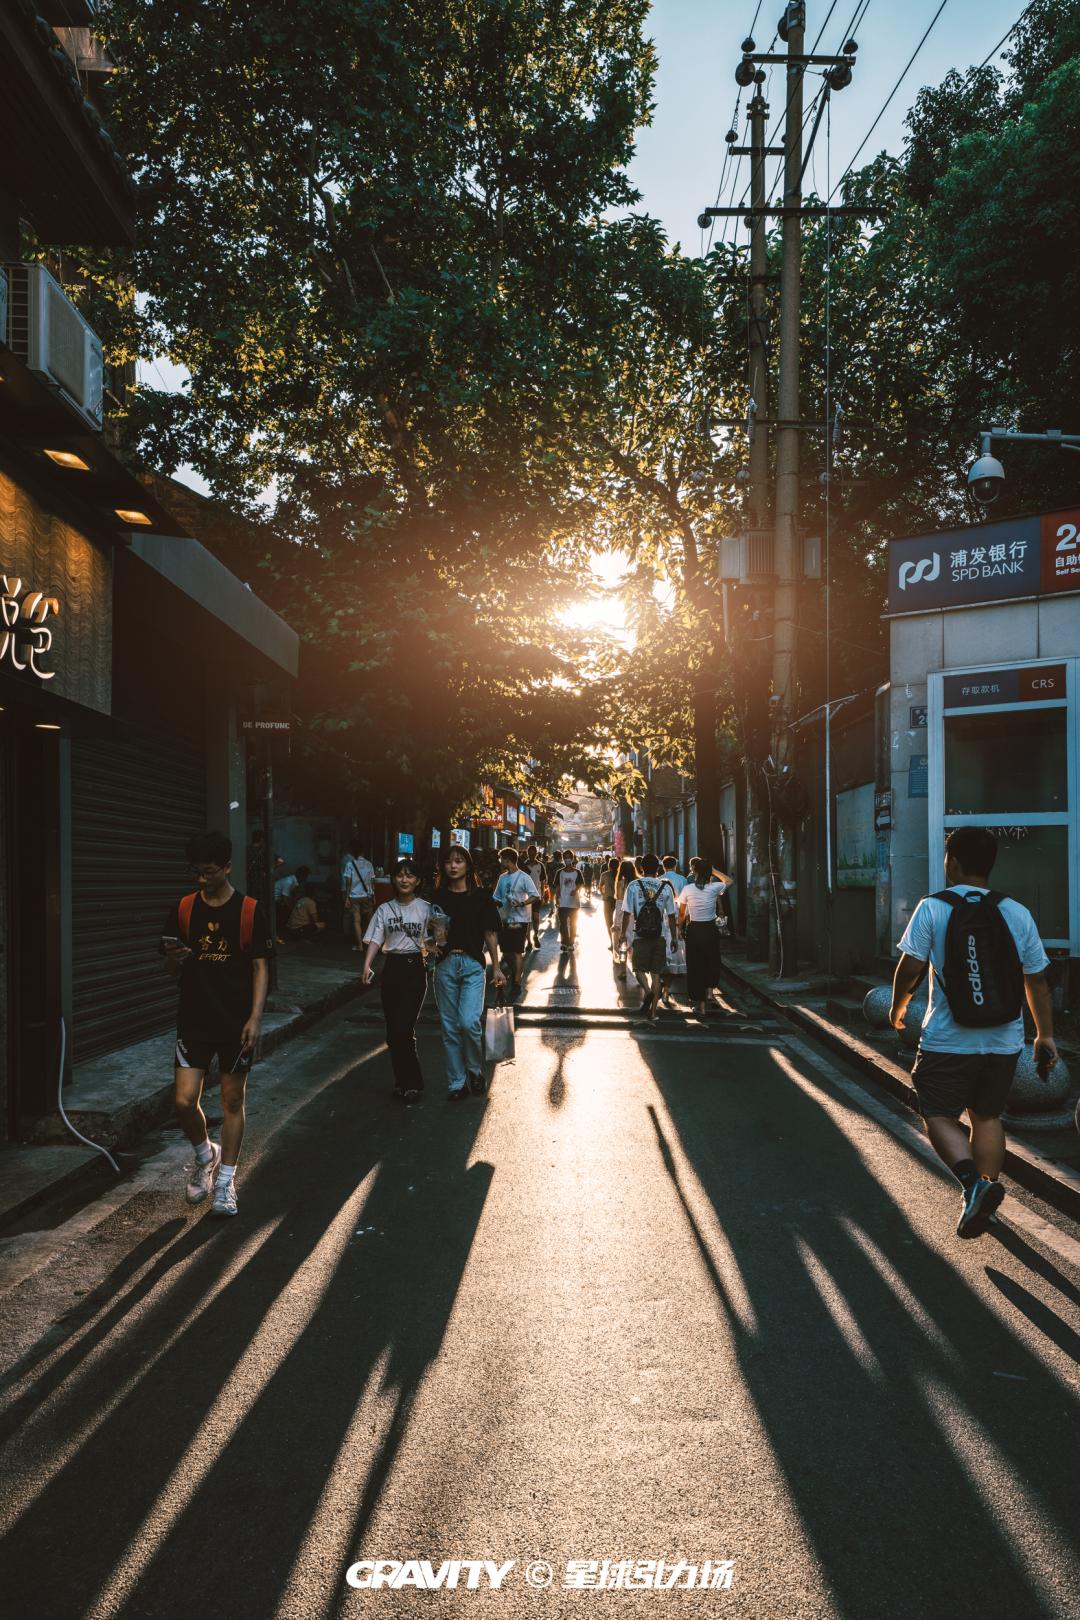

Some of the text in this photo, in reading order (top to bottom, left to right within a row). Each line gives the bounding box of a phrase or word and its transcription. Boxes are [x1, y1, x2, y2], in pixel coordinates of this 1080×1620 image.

[1056, 523, 1080, 551] 2
[950, 541, 1028, 568] 浦发银行
[1056, 555, 1080, 568] 自助
[952, 560, 1024, 582] SPD BANK
[1031, 679, 1055, 689] CRS
[388, 922, 422, 934] DACING
[967, 934, 984, 1006] adidas
